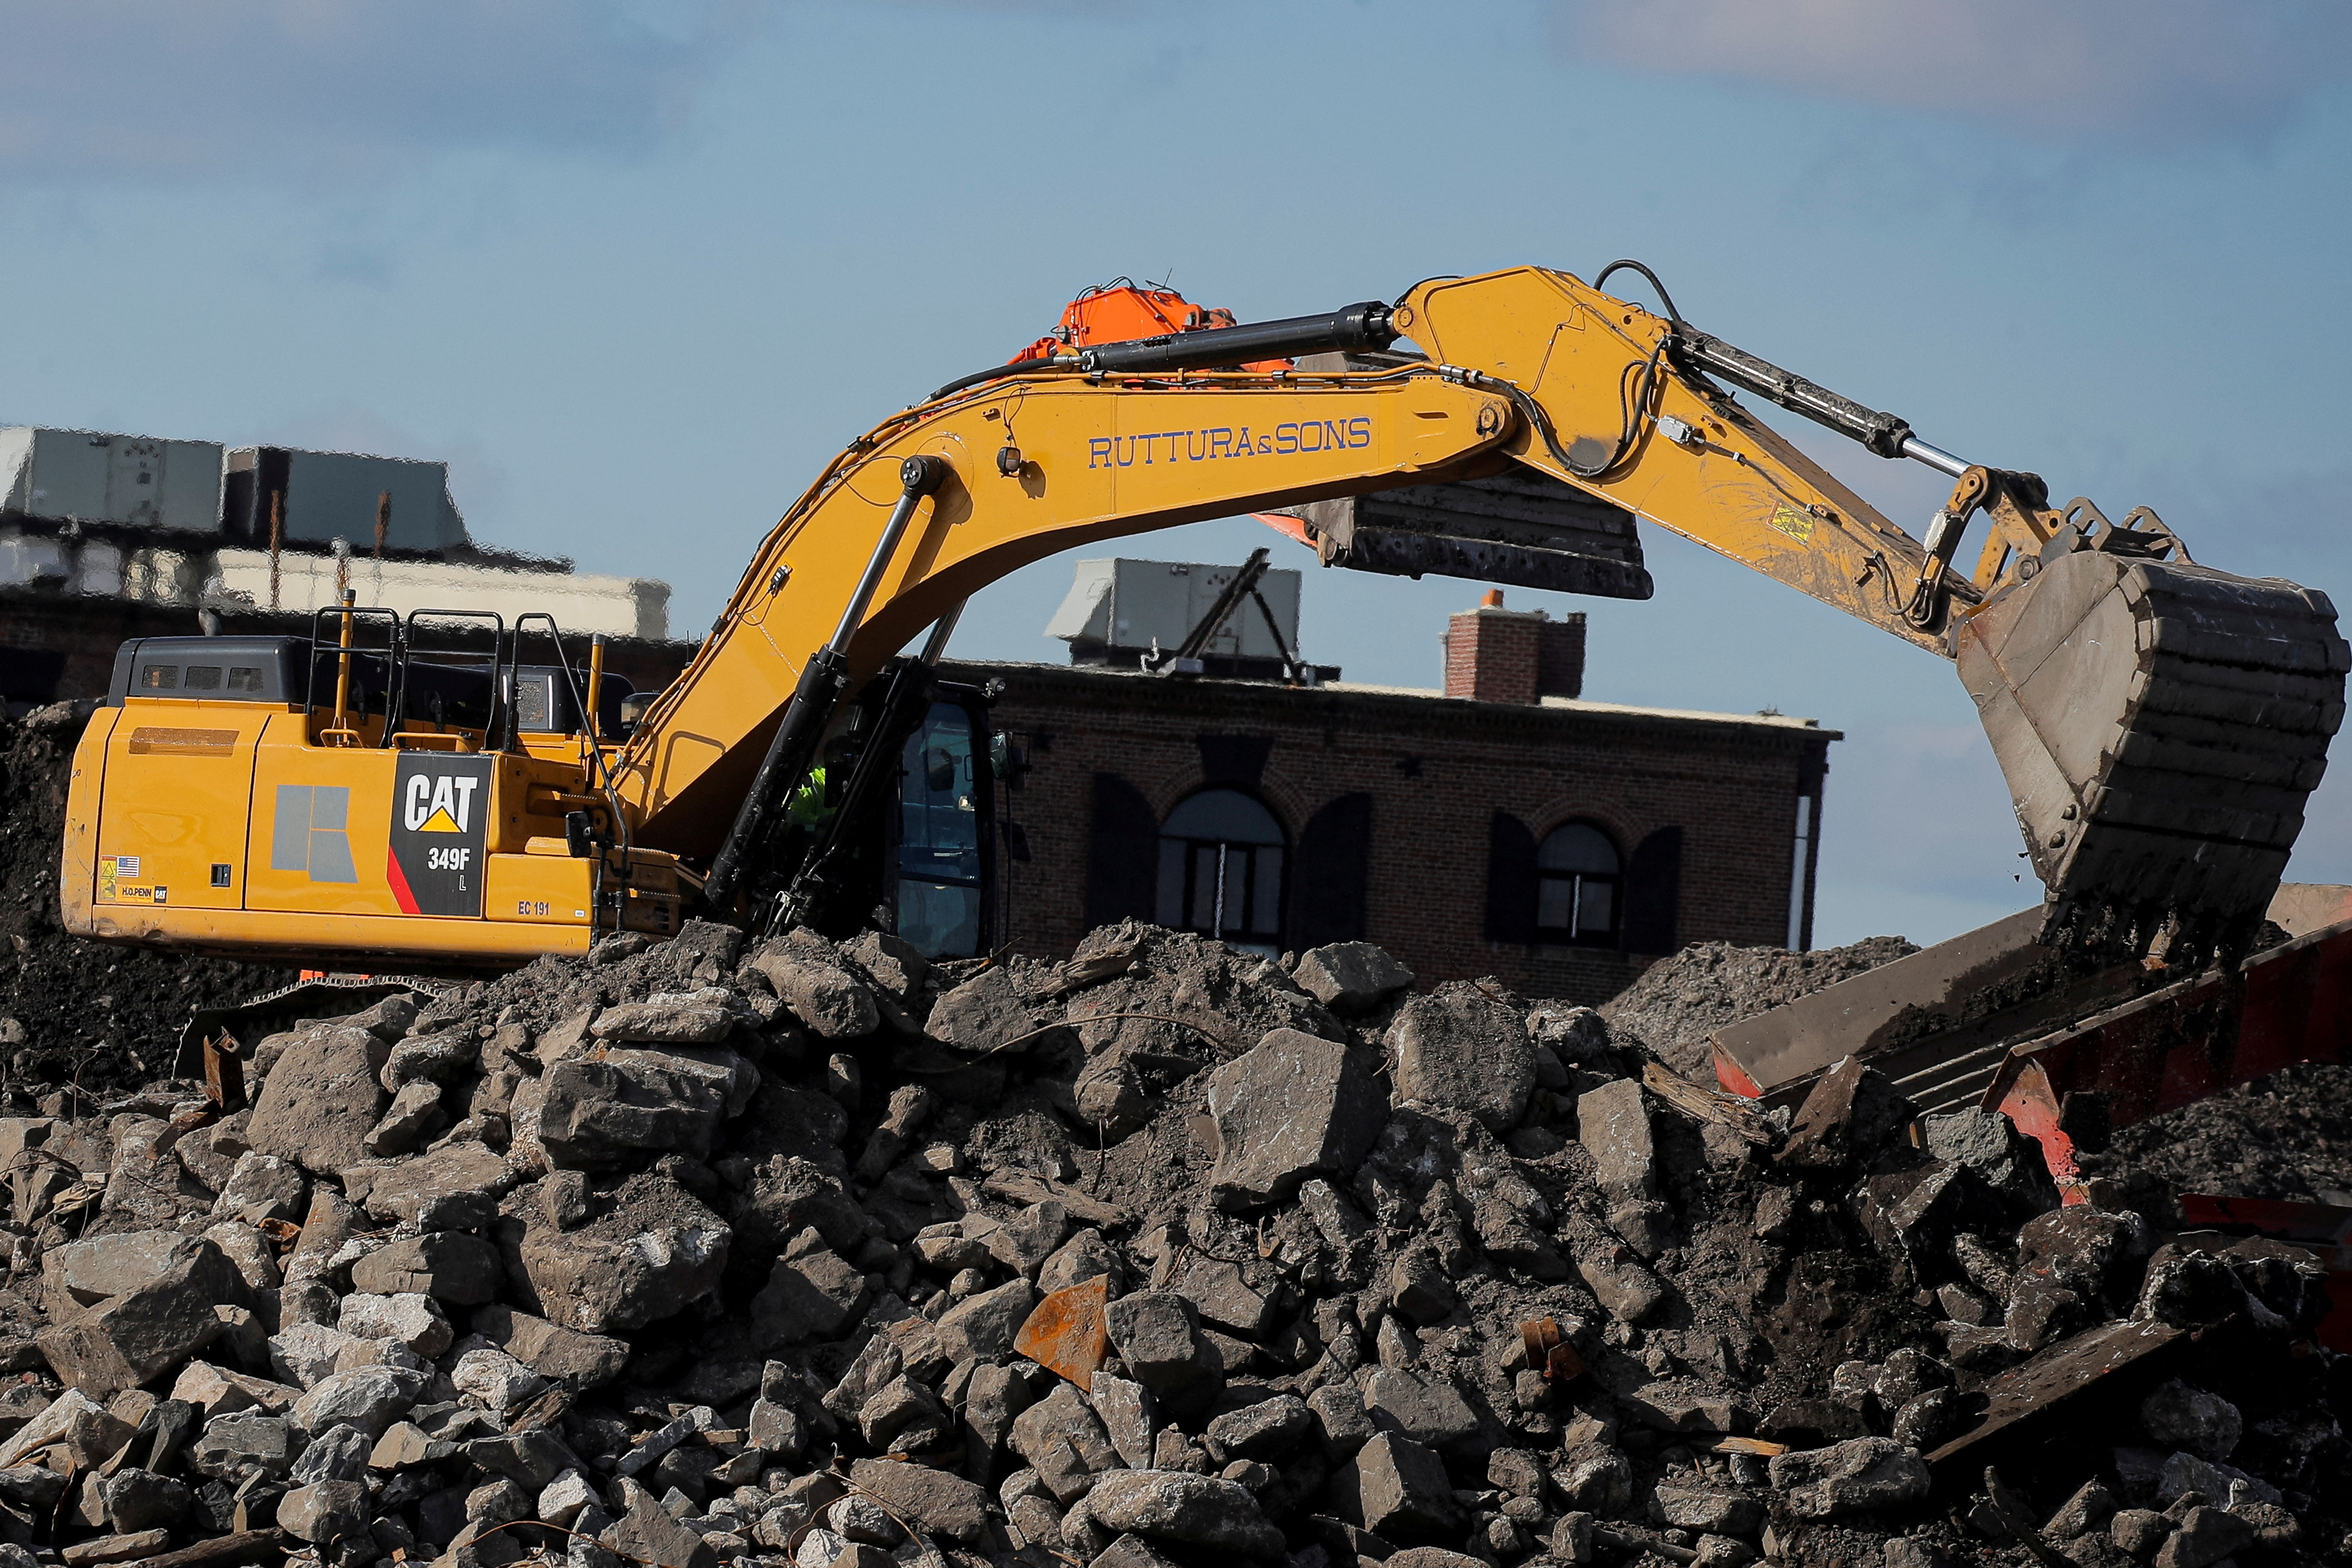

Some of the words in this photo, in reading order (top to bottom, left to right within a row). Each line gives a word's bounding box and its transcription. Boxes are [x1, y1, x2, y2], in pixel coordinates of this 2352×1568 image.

[404, 774, 478, 833] CAT
[427, 847, 471, 870] 349F
[459, 874, 467, 891] L
[155, 890, 167, 899] CAT
[518, 900, 531, 915] EC
[534, 901, 549, 916] 191
